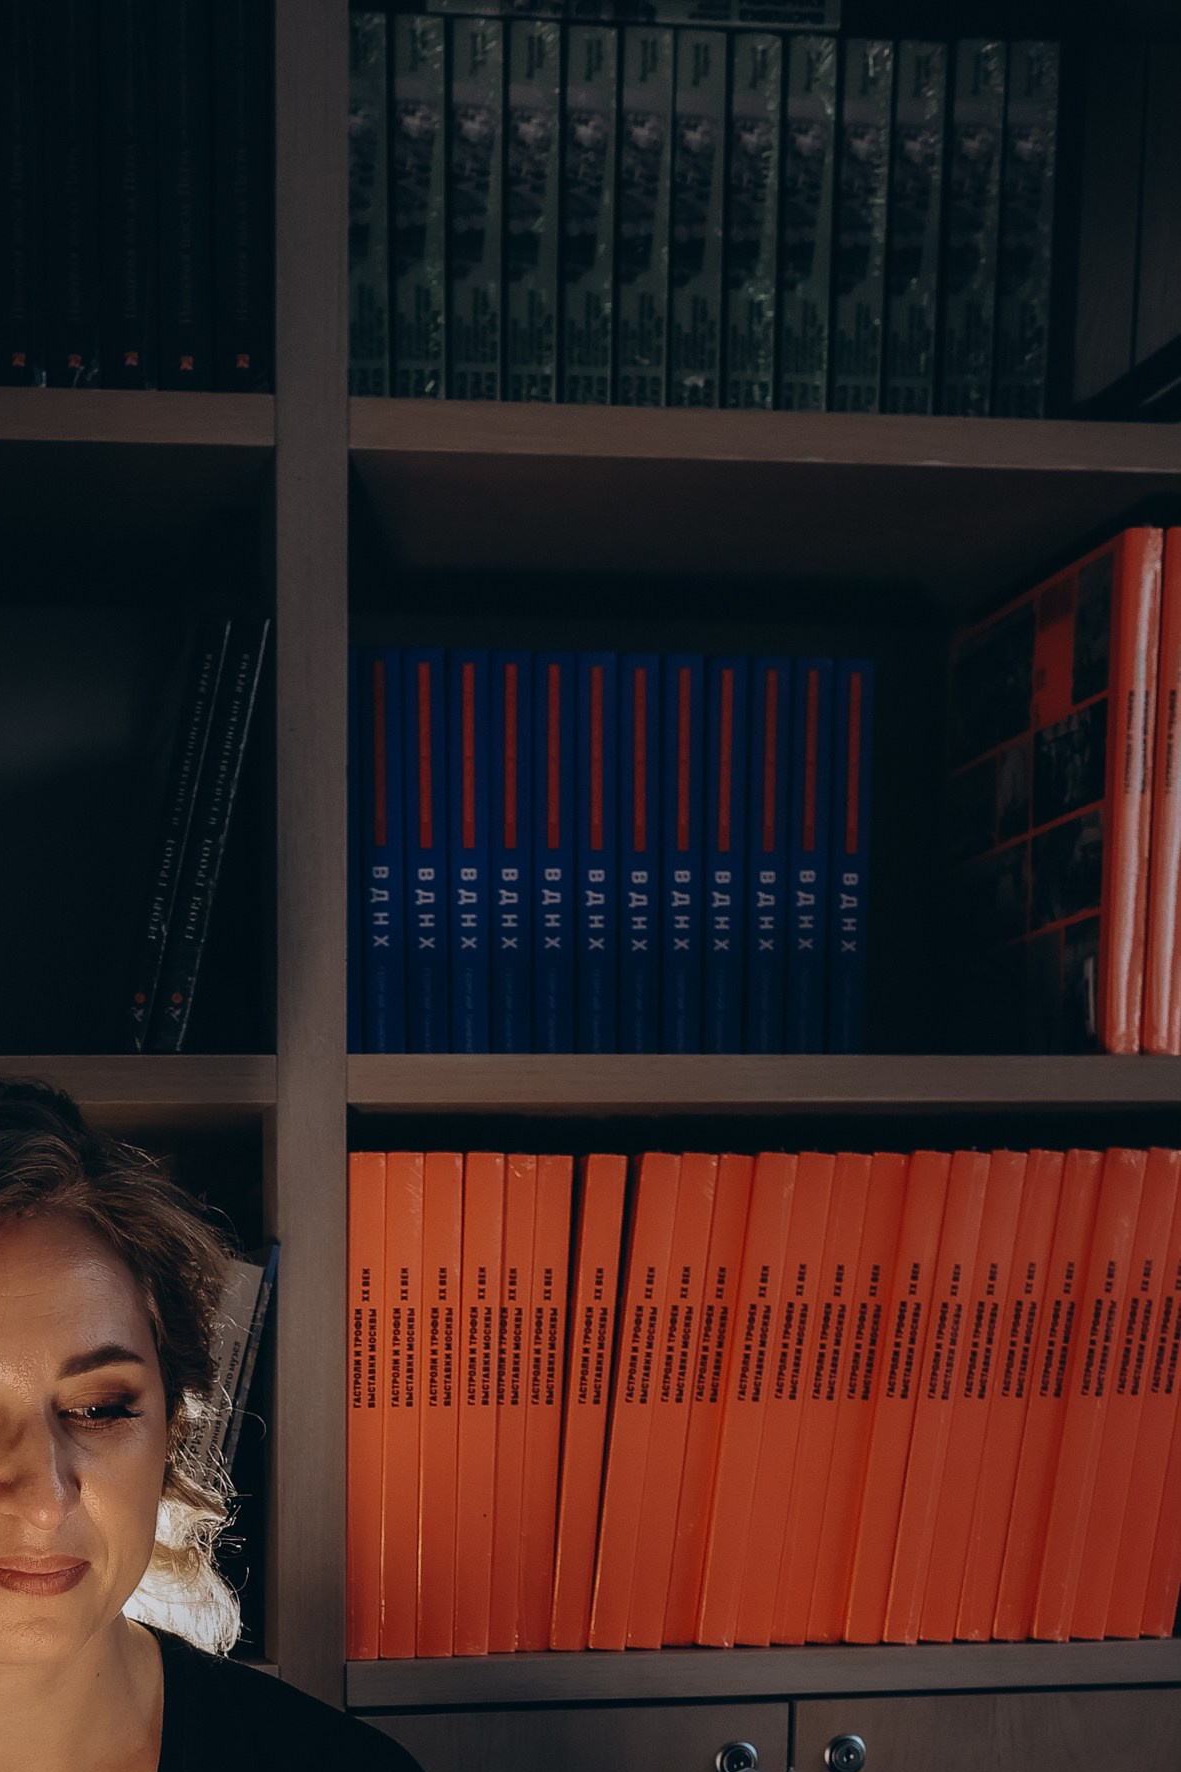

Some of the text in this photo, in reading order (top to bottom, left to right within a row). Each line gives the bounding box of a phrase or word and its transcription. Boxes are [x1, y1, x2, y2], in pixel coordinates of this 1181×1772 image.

[369, 866, 390, 948] ВДНХ
[415, 867, 436, 949] ВДНХ
[457, 867, 478, 950] ВДНХ
[498, 867, 519, 950] ВДНХ
[541, 867, 562, 950] ВДНХ
[584, 868, 606, 950] ВДНХ
[628, 870, 649, 951] ВДНХ
[671, 869, 691, 951] ВДНХ
[712, 870, 732, 951] ВДНХ
[756, 870, 777, 951] ВДНХ
[796, 869, 816, 951] ВДНХ
[838, 872, 859, 952] ВДНХ
[354, 1308, 363, 1347] ТРОФЕИ
[368, 1308, 377, 1408] ВЫСТАВКИ МОСКВЫ
[430, 1307, 439, 1346] ТРОФЕИ
[444, 1307, 453, 1406] ВЫСТАВКИ МОСКВЫ
[626, 1355, 637, 1403] ГАСТРОЛИ
[633, 1306, 644, 1344] ТРОФЕИ
[640, 1307, 657, 1404] ВЫСТАВКИ МОСКВЫ
[353, 1358, 362, 1408] ГАСТРОЛИ
[430, 1357, 438, 1406] ГАСТРОЛИ
